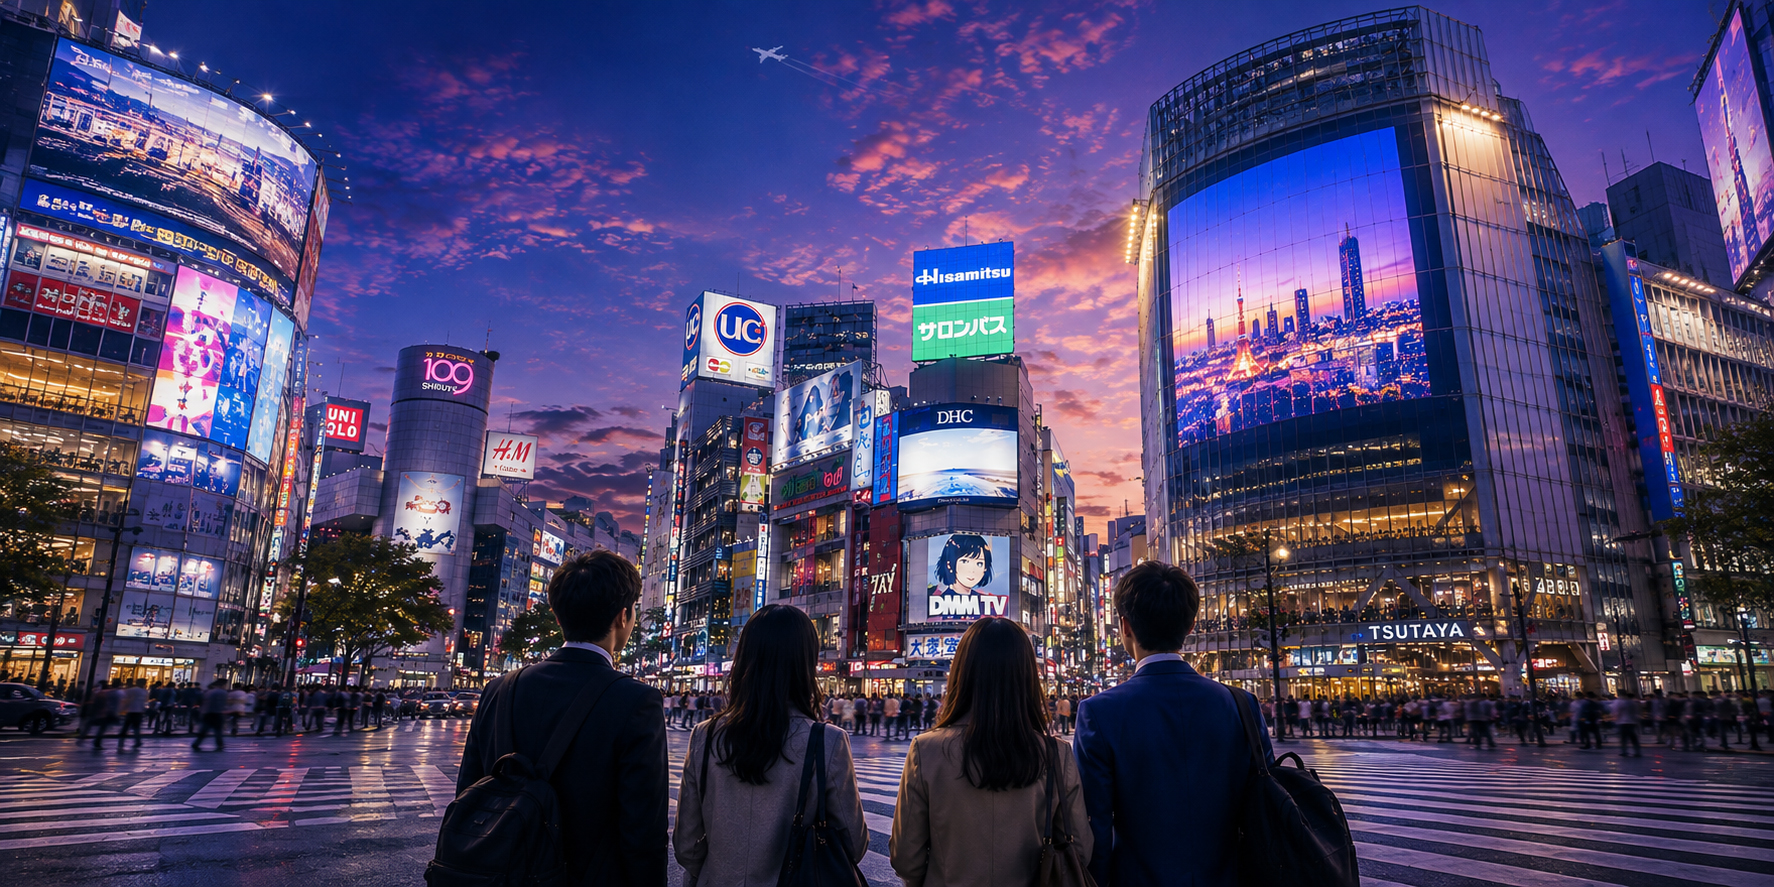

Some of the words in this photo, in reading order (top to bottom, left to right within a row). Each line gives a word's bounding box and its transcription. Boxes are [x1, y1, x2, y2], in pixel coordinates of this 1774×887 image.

[915, 267, 1011, 286] Hisamitsu
[720, 313, 762, 344] UC
[423, 357, 474, 396] 109
[328, 407, 356, 424] UNI
[936, 409, 974, 425] DHC
[928, 594, 980, 616] DMM
[980, 595, 1008, 616] TV
[1368, 622, 1465, 640] TSUTAYA
